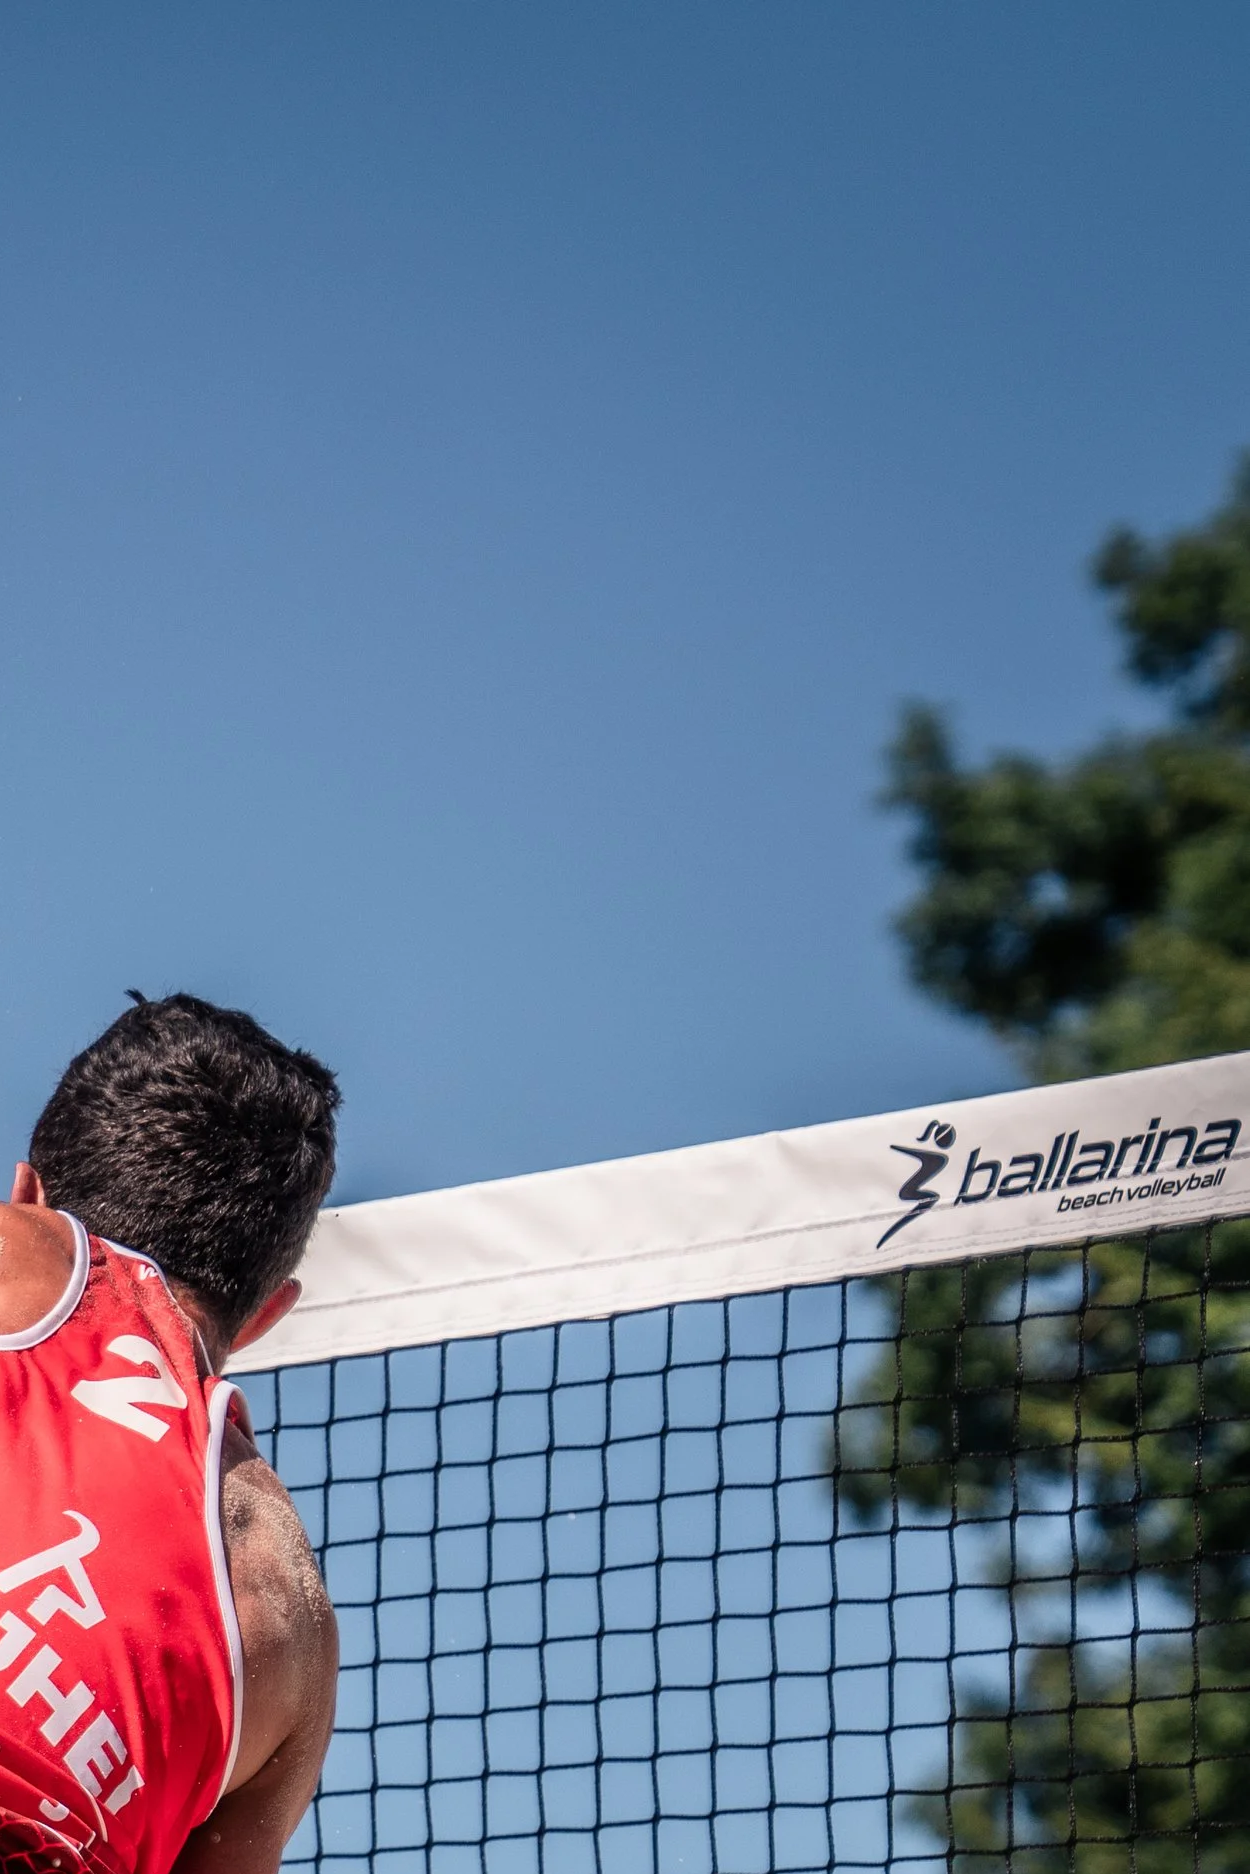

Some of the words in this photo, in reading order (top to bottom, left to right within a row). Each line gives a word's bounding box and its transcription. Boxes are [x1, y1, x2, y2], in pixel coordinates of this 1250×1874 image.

[954, 1117, 1242, 1206] ballarina
[1057, 1186, 1124, 1213] beach
[1126, 1168, 1227, 1203] volleyball
[71, 1334, 188, 1443] 2
